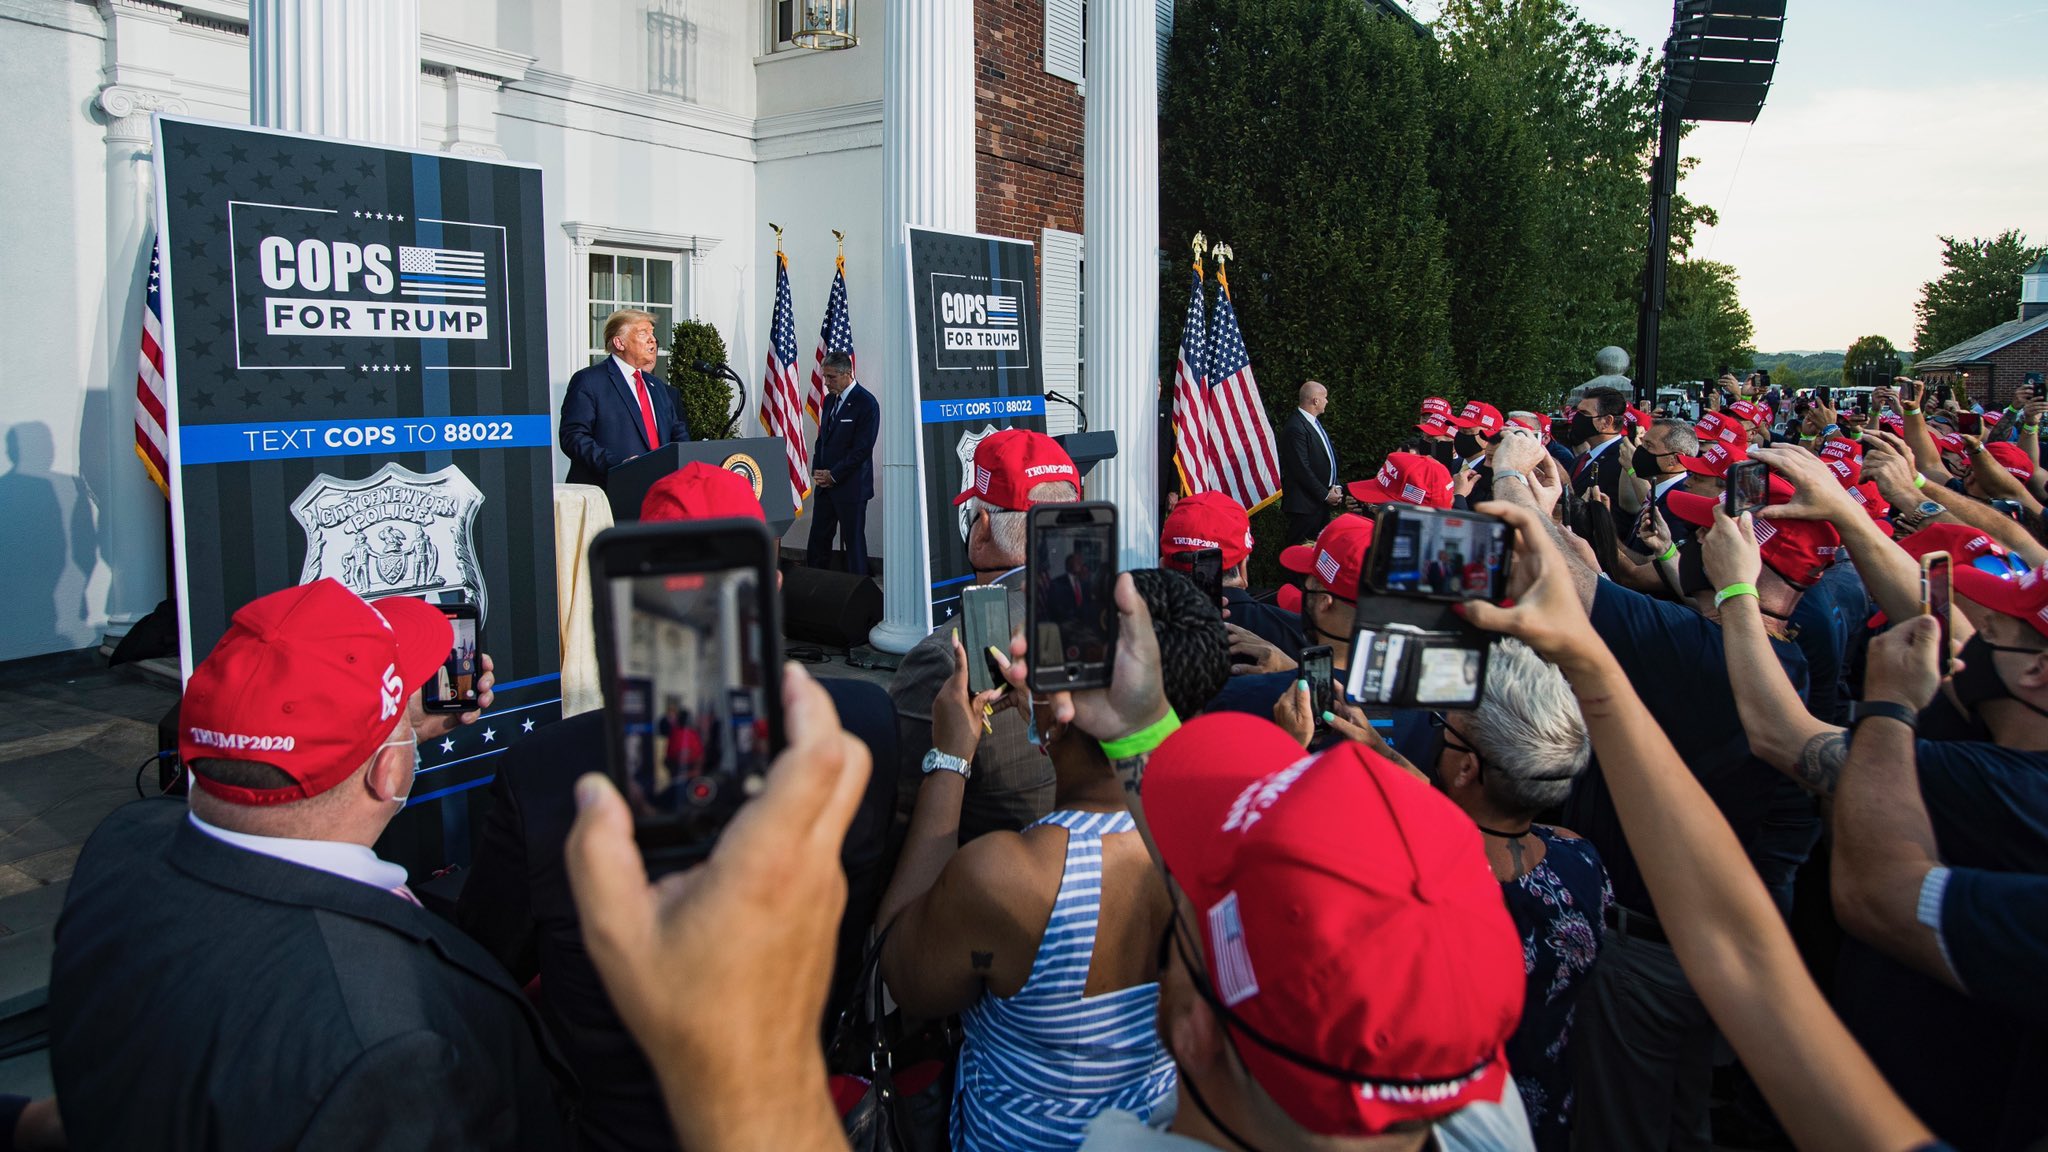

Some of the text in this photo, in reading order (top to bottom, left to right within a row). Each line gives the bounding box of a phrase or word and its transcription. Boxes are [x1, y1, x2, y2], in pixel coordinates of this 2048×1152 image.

[260, 236, 395, 295] COPS
[274, 305, 483, 333] FOR TRUMP
[941, 292, 986, 325] COPS
[947, 332, 1018, 347] FOR TRUMP
[940, 400, 1032, 417] TEXT COPS TO 88022
[243, 422, 513, 452] TEXT COPS TO 88022
[1025, 464, 1073, 478] TRUMP2020
[320, 486, 458, 526] CITY OF NEW YORK
[354, 504, 430, 530] POLICE
[1173, 536, 1219, 549] TRUMP2020
[381, 662, 404, 722] 45
[190, 727, 296, 752] TRUMP2020
